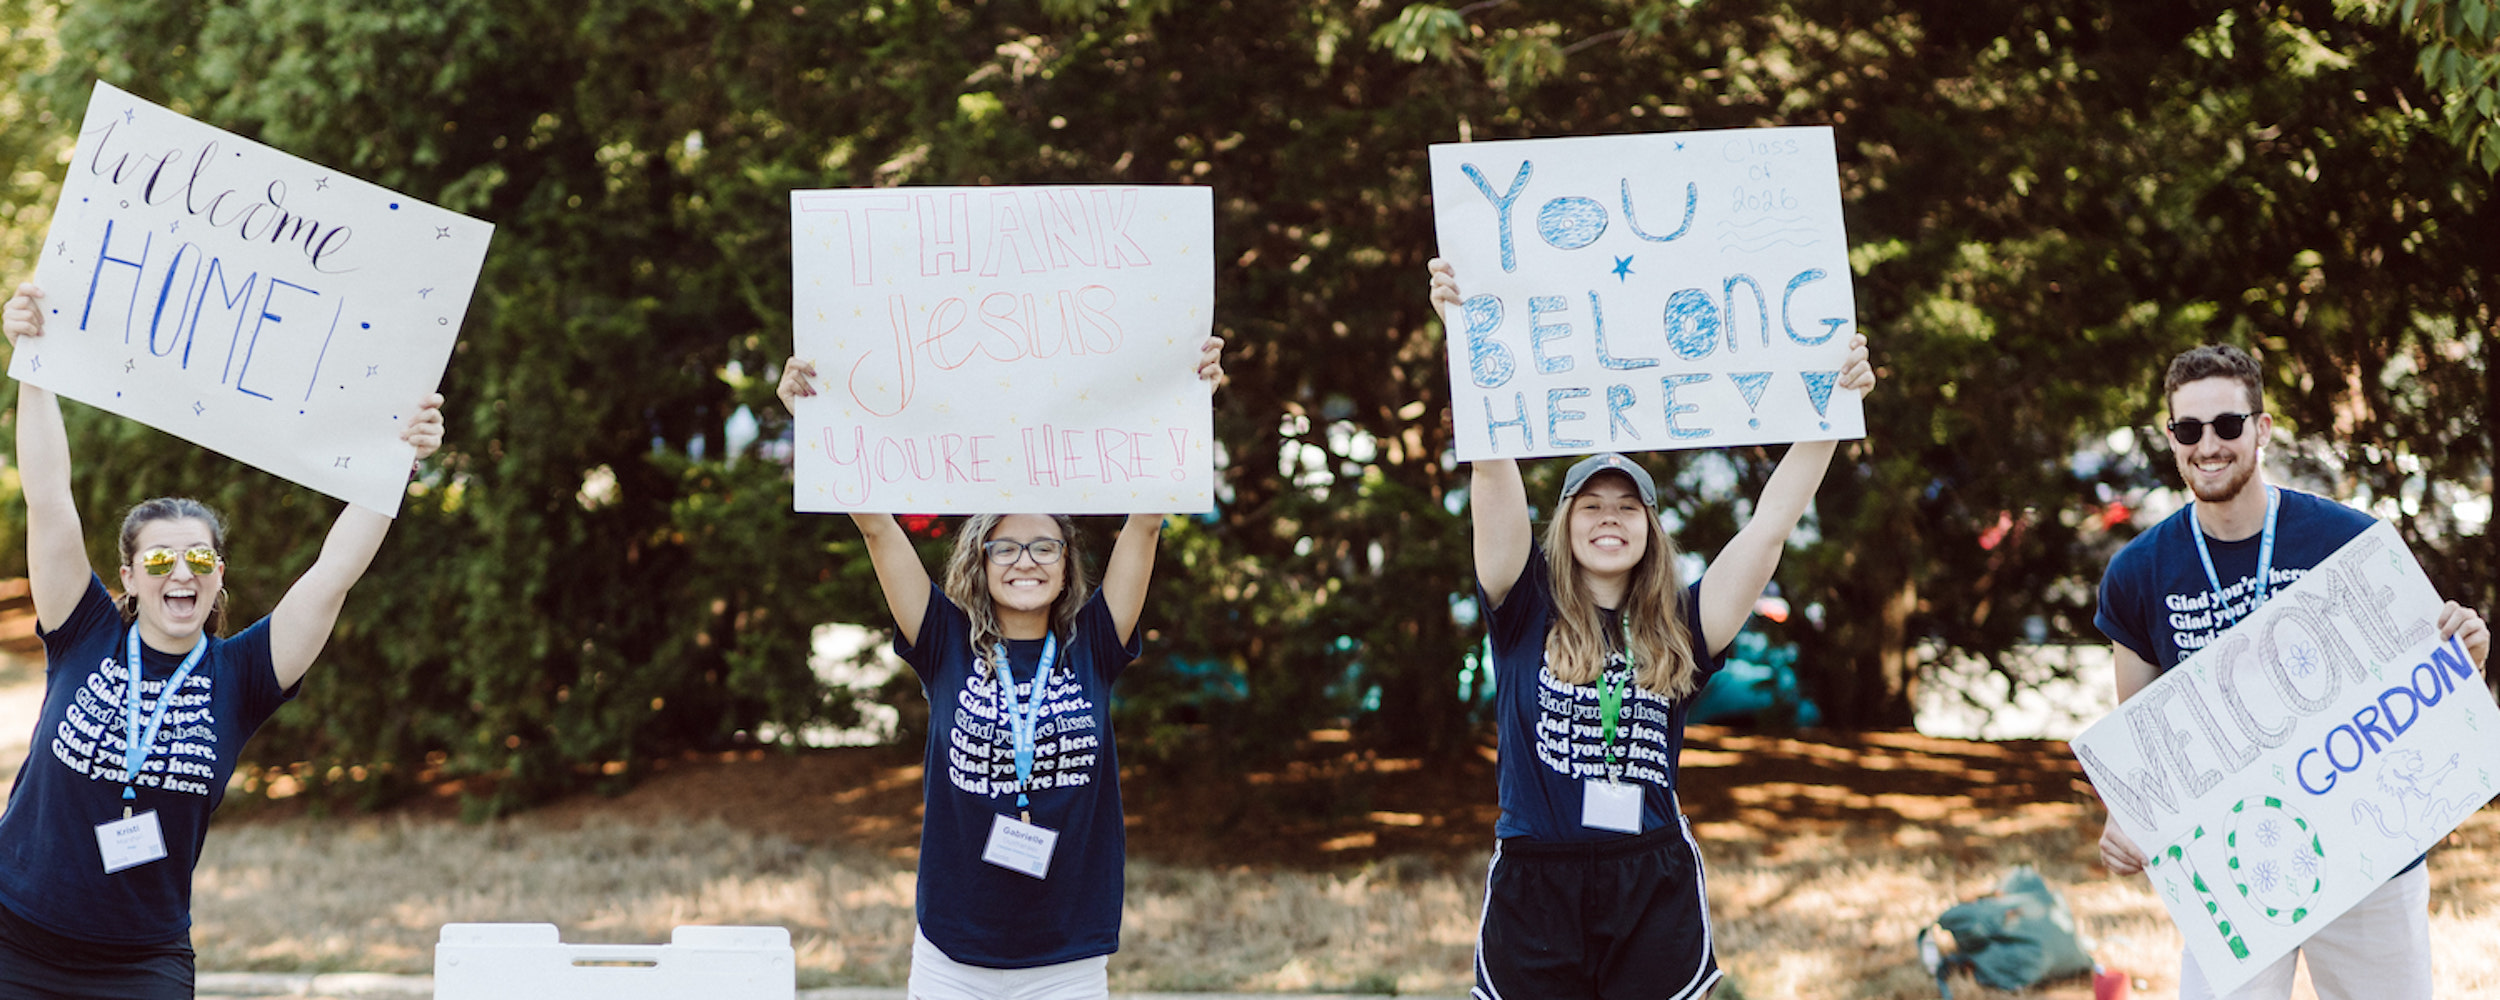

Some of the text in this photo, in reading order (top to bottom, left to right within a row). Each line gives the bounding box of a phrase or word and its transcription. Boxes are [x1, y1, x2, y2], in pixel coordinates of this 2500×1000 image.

[1723, 138, 1799, 163] Class
[1733, 185, 1798, 213] 2026
[1461, 160, 1697, 273] YOU
[799, 188, 1153, 286] THANK
[79, 219, 344, 415] HOME!
[2165, 590, 2211, 612] Glad
[2210, 575, 2258, 609] you'r
[2168, 608, 2213, 630] Glad
[2079, 535, 2435, 832] WELCOME
[66, 703, 105, 740] Glad
[958, 689, 998, 720] Glad
[2296, 635, 2474, 796] GORDON
[58, 720, 97, 758] Glad
[955, 708, 996, 740] Glad
[950, 727, 991, 759] Glad
[51, 738, 91, 775] Glad
[161, 774, 209, 796] here.
[949, 747, 990, 775] Glad
[1625, 761, 1669, 788] here.
[949, 766, 989, 795] Glad
[1003, 826, 1044, 845] Gabrielle
[2151, 795, 2327, 965] TO
